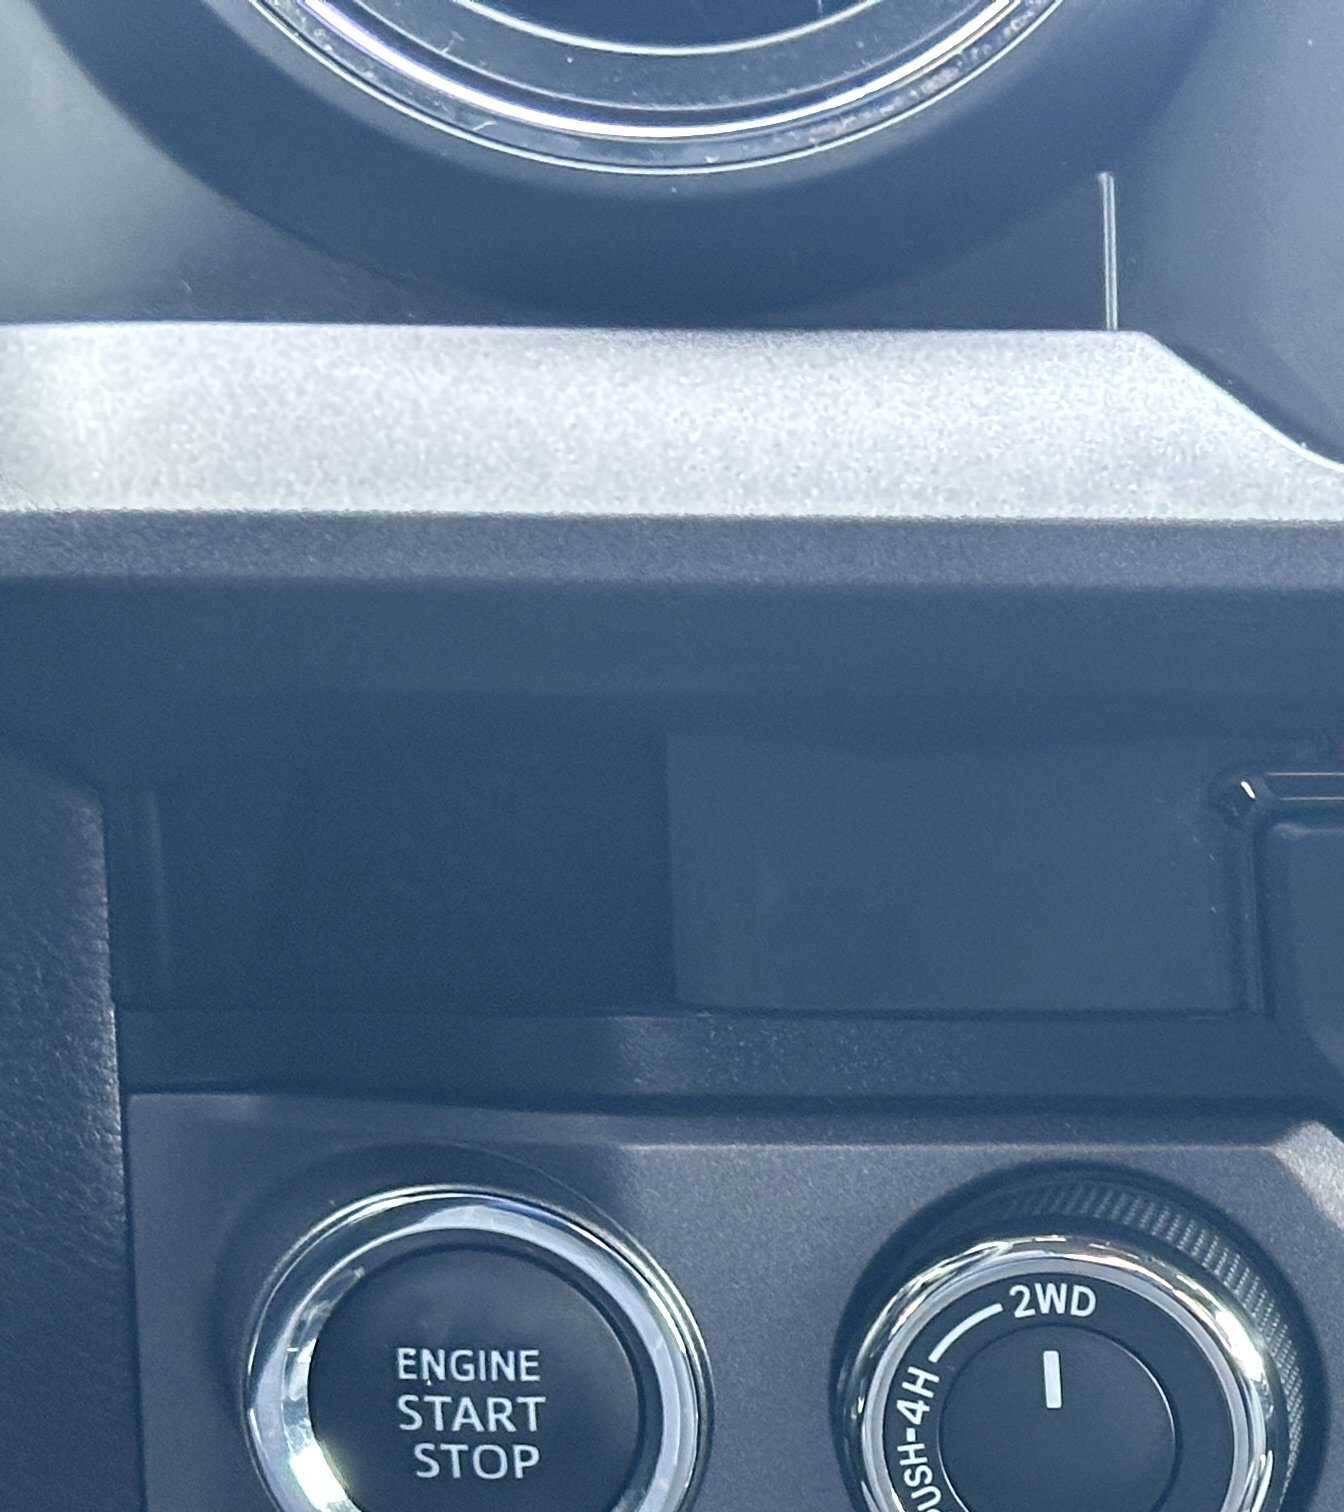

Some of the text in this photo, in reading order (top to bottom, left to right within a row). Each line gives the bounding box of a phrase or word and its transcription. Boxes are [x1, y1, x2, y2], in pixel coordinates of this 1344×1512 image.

[1009, 1283, 1098, 1319] 2WD
[397, 1347, 541, 1383] ENGINE
[398, 1394, 546, 1432] START
[414, 1442, 540, 1480] STOP
